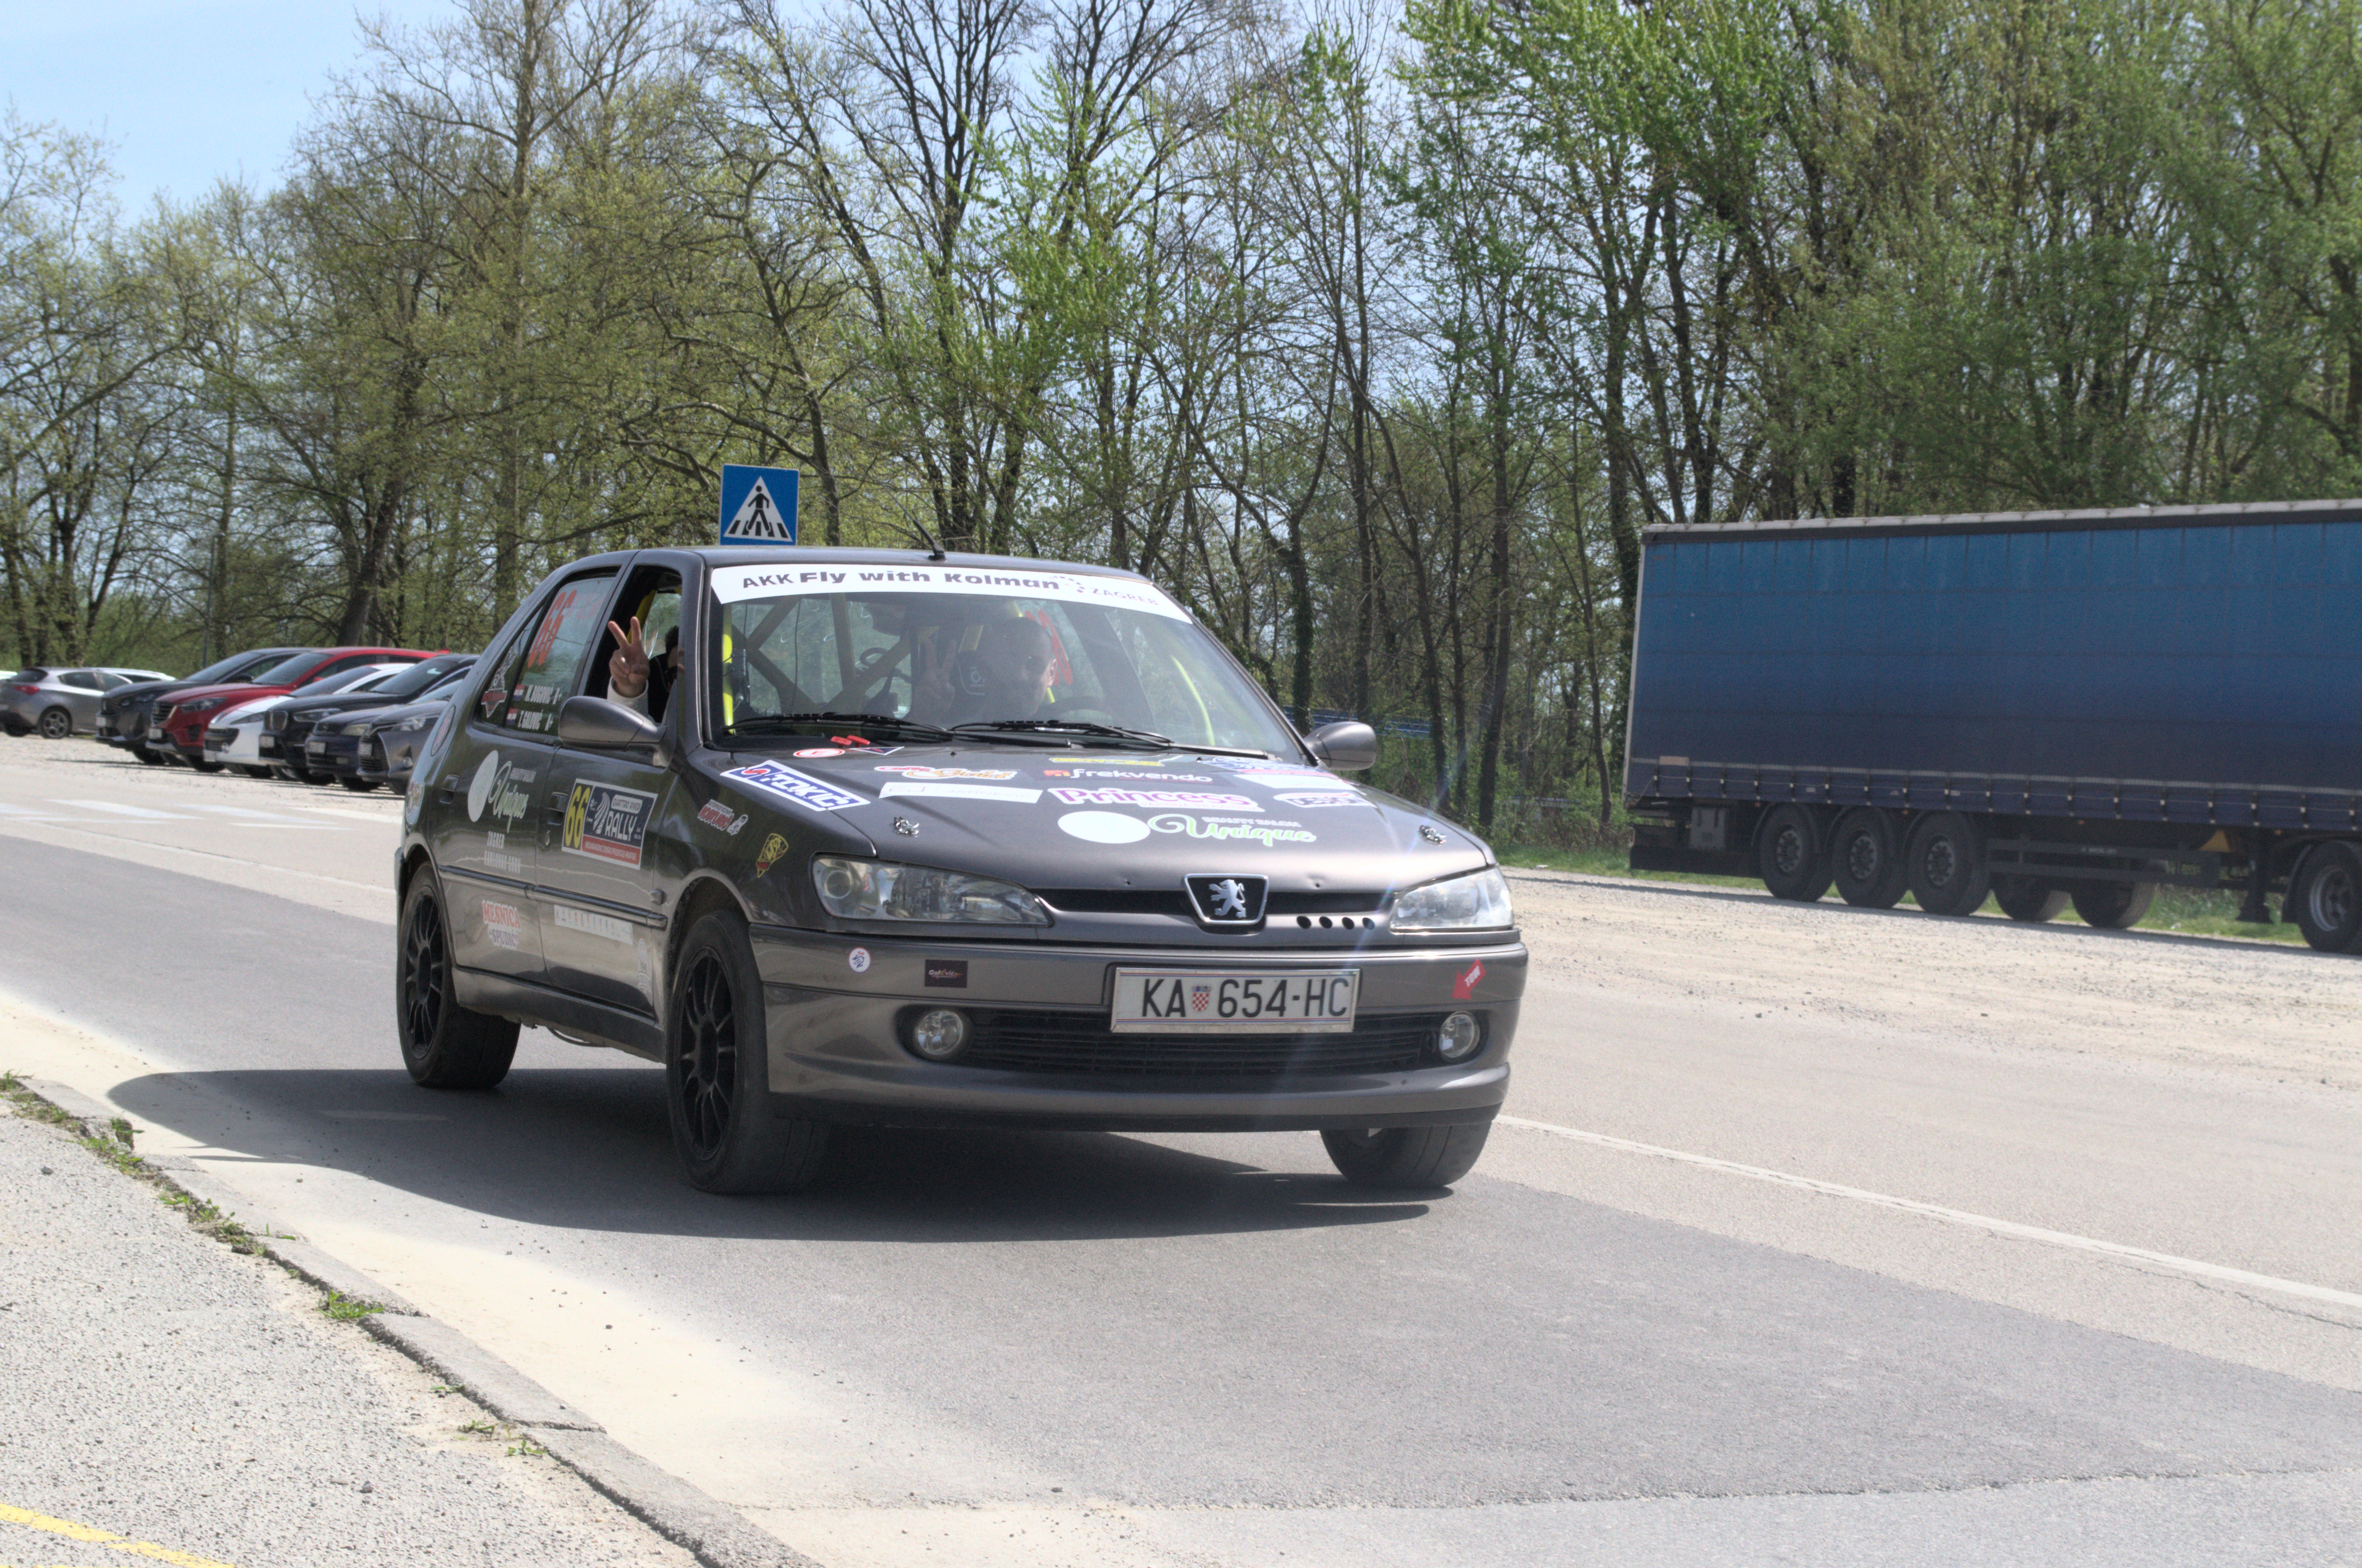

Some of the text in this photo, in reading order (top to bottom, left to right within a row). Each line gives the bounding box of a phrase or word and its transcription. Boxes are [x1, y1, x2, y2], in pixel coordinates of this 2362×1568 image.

[743, 570, 1060, 591] AKK Fly with Kolman
[1090, 588, 1159, 606] ZAGREB
[528, 589, 577, 668] 66
[906, 769, 1014, 779] Gold
[1070, 769, 1213, 782] frekvendo
[1055, 789, 1251, 805] Princess
[565, 785, 591, 849] 66
[605, 811, 638, 842] RALLY
[487, 831, 505, 849] ZAGREB
[1147, 814, 1317, 847] Unique
[483, 902, 521, 930] MESNICA
[1464, 964, 1481, 987] TOW
[1142, 978, 1350, 1018] KA 654-HC
